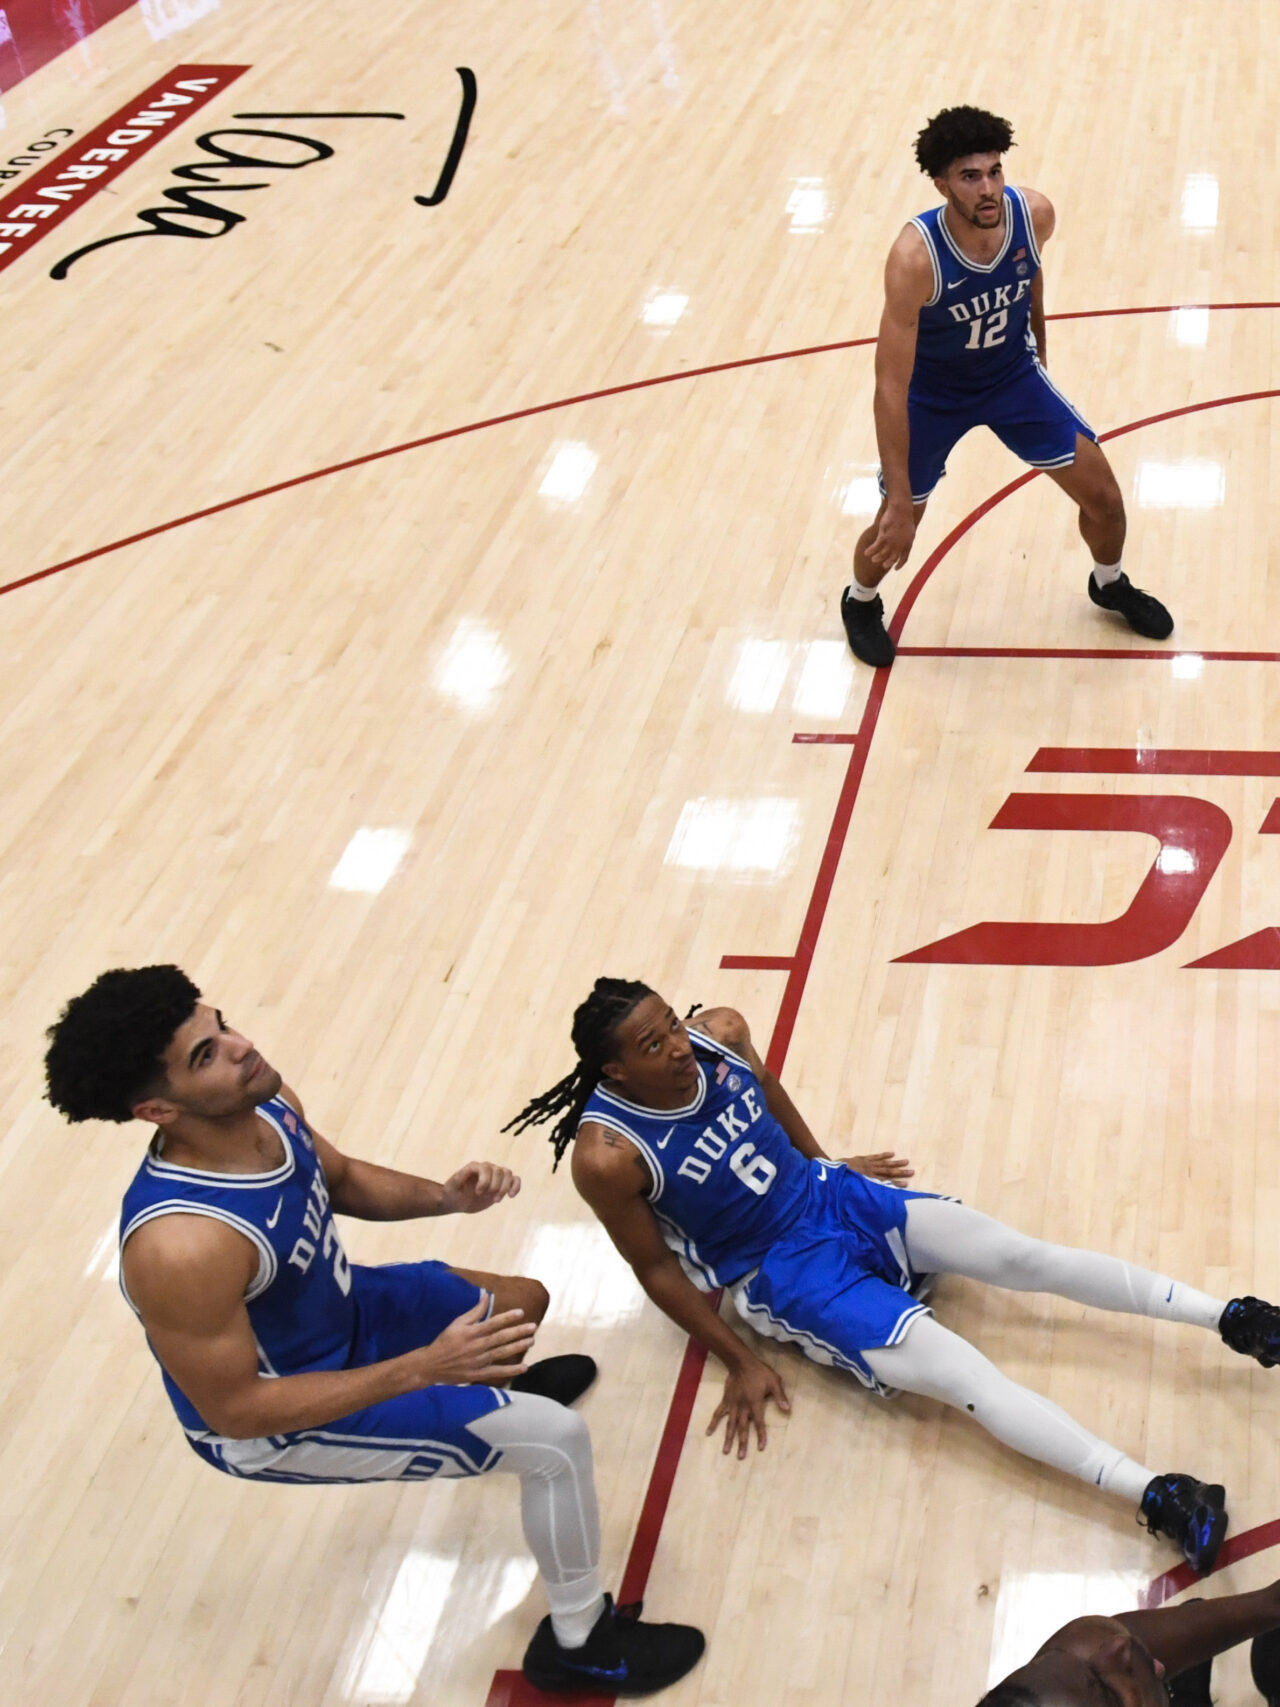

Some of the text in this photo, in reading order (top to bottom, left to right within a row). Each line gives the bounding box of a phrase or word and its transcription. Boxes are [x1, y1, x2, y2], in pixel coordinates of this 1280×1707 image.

[0, 128, 75, 188] COUR
[948, 279, 1031, 322] DUKE
[965, 309, 1009, 349] 12
[677, 1087, 762, 1184] DUKE
[729, 1142, 777, 1196] 6
[287, 1155, 331, 1275] DUK
